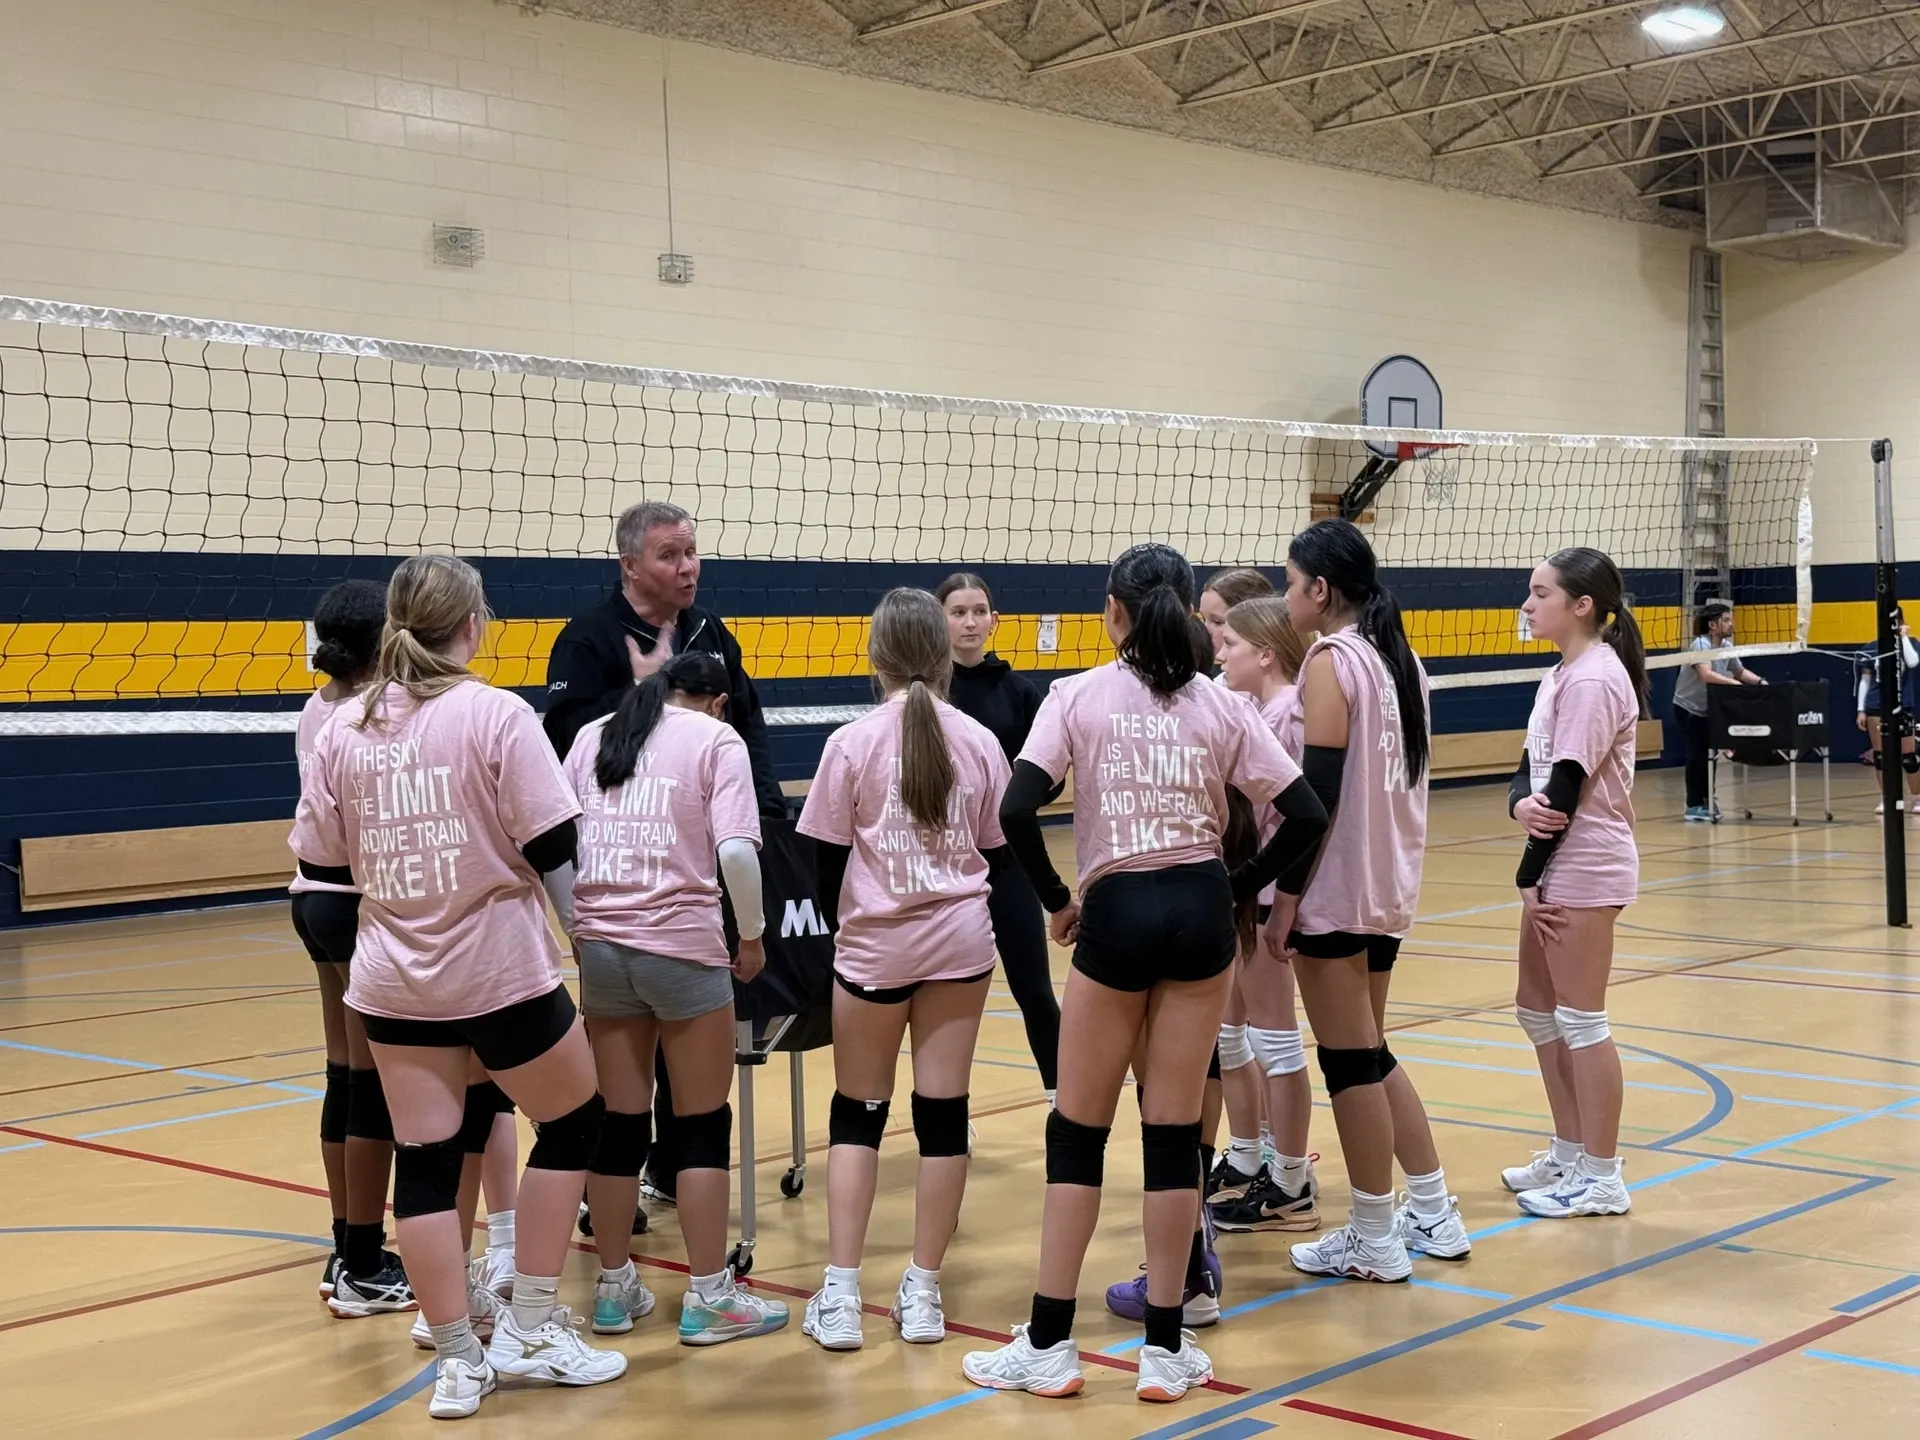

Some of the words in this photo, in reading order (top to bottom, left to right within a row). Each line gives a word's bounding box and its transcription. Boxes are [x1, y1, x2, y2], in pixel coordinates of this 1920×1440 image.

[1109, 713, 1142, 738] THE
[1146, 714, 1180, 740] SKY
[1381, 706, 1397, 720] HE
[354, 744, 387, 773] THE
[389, 737, 422, 768] SKY
[1101, 761, 1132, 780] THE
[1133, 744, 1208, 788] LIMIT
[1107, 743, 1122, 760] IS
[352, 778, 365, 797] IS
[376, 766, 452, 821] LIMIT
[581, 794, 602, 810] THE
[603, 777, 678, 817] LIMIT
[1100, 791, 1136, 816] AND
[1140, 790, 1169, 813] WE
[1164, 792, 1212, 815] TRAIN
[380, 825, 410, 853] WE
[413, 817, 469, 849] TRAIN
[603, 822, 627, 845] WE
[631, 822, 677, 846] TRAIN
[878, 830, 910, 852] AND
[1110, 816, 1181, 859] LIKE
[433, 848, 461, 893] IT
[642, 848, 669, 886] IT
[887, 854, 947, 894] LIKE
[947, 853, 972, 886] IT
